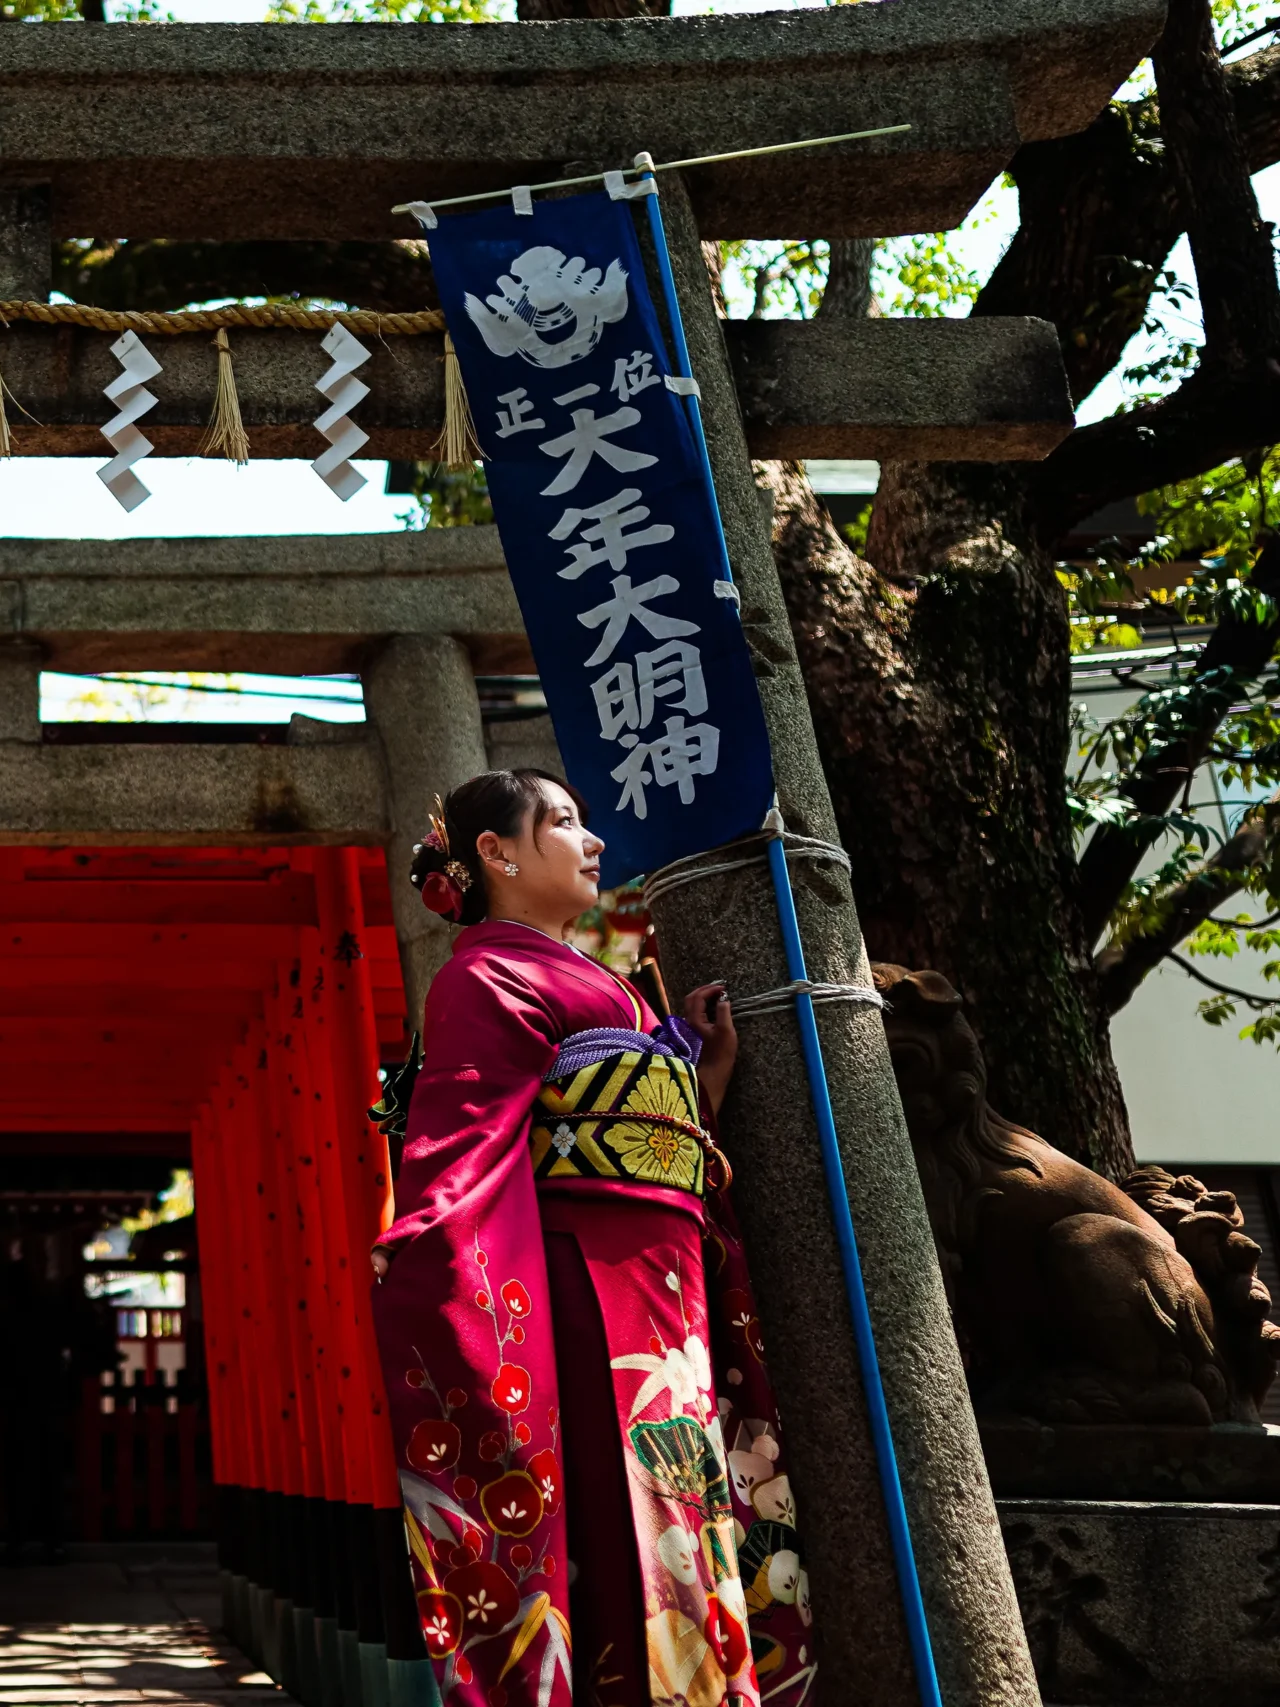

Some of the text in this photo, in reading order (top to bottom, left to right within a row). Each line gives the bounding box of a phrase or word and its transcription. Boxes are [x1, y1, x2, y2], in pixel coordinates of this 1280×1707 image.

[494, 351, 661, 439] 正一位
[539, 406, 720, 820] 大年大明神
